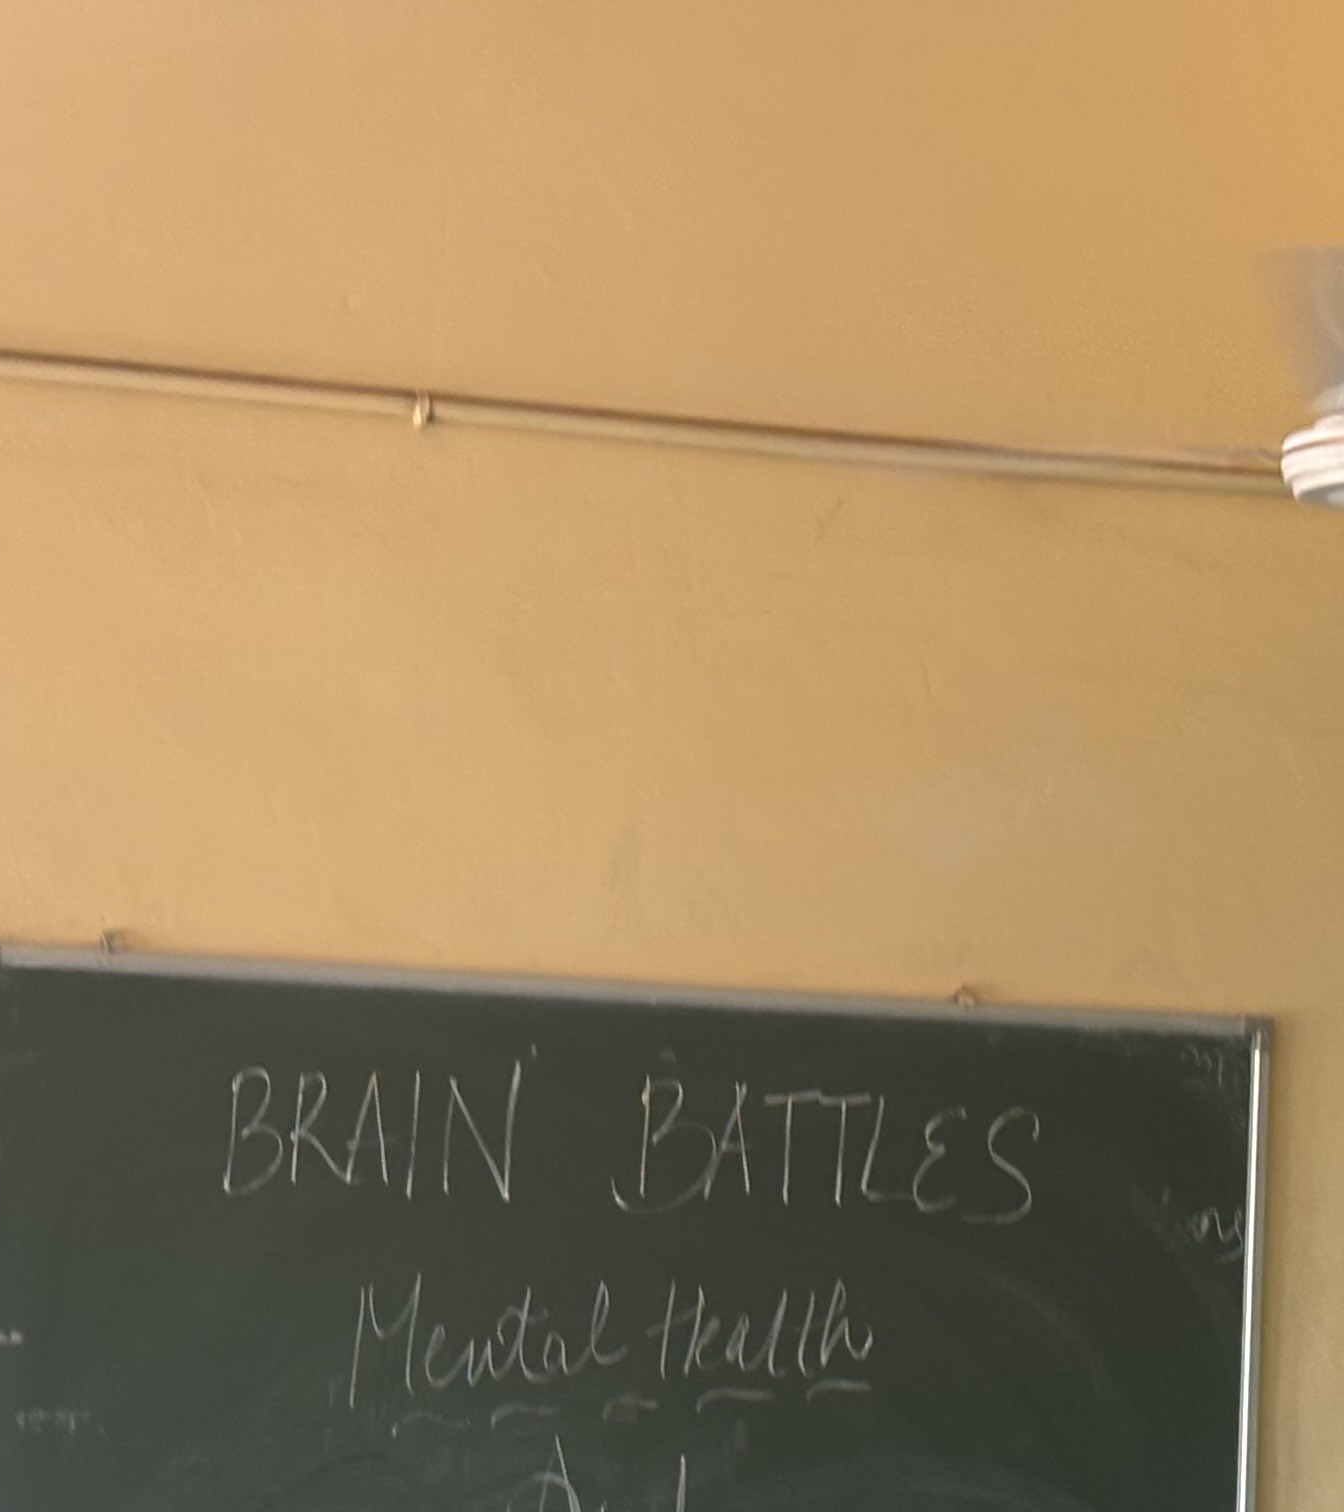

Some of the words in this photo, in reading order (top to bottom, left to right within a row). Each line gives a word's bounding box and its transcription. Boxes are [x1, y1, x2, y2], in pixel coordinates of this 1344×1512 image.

[222, 1059, 522, 1203] BRAIN
[611, 1073, 1040, 1224] BATTLES
[349, 1272, 628, 1408] Mental
[647, 1277, 873, 1380] Health
